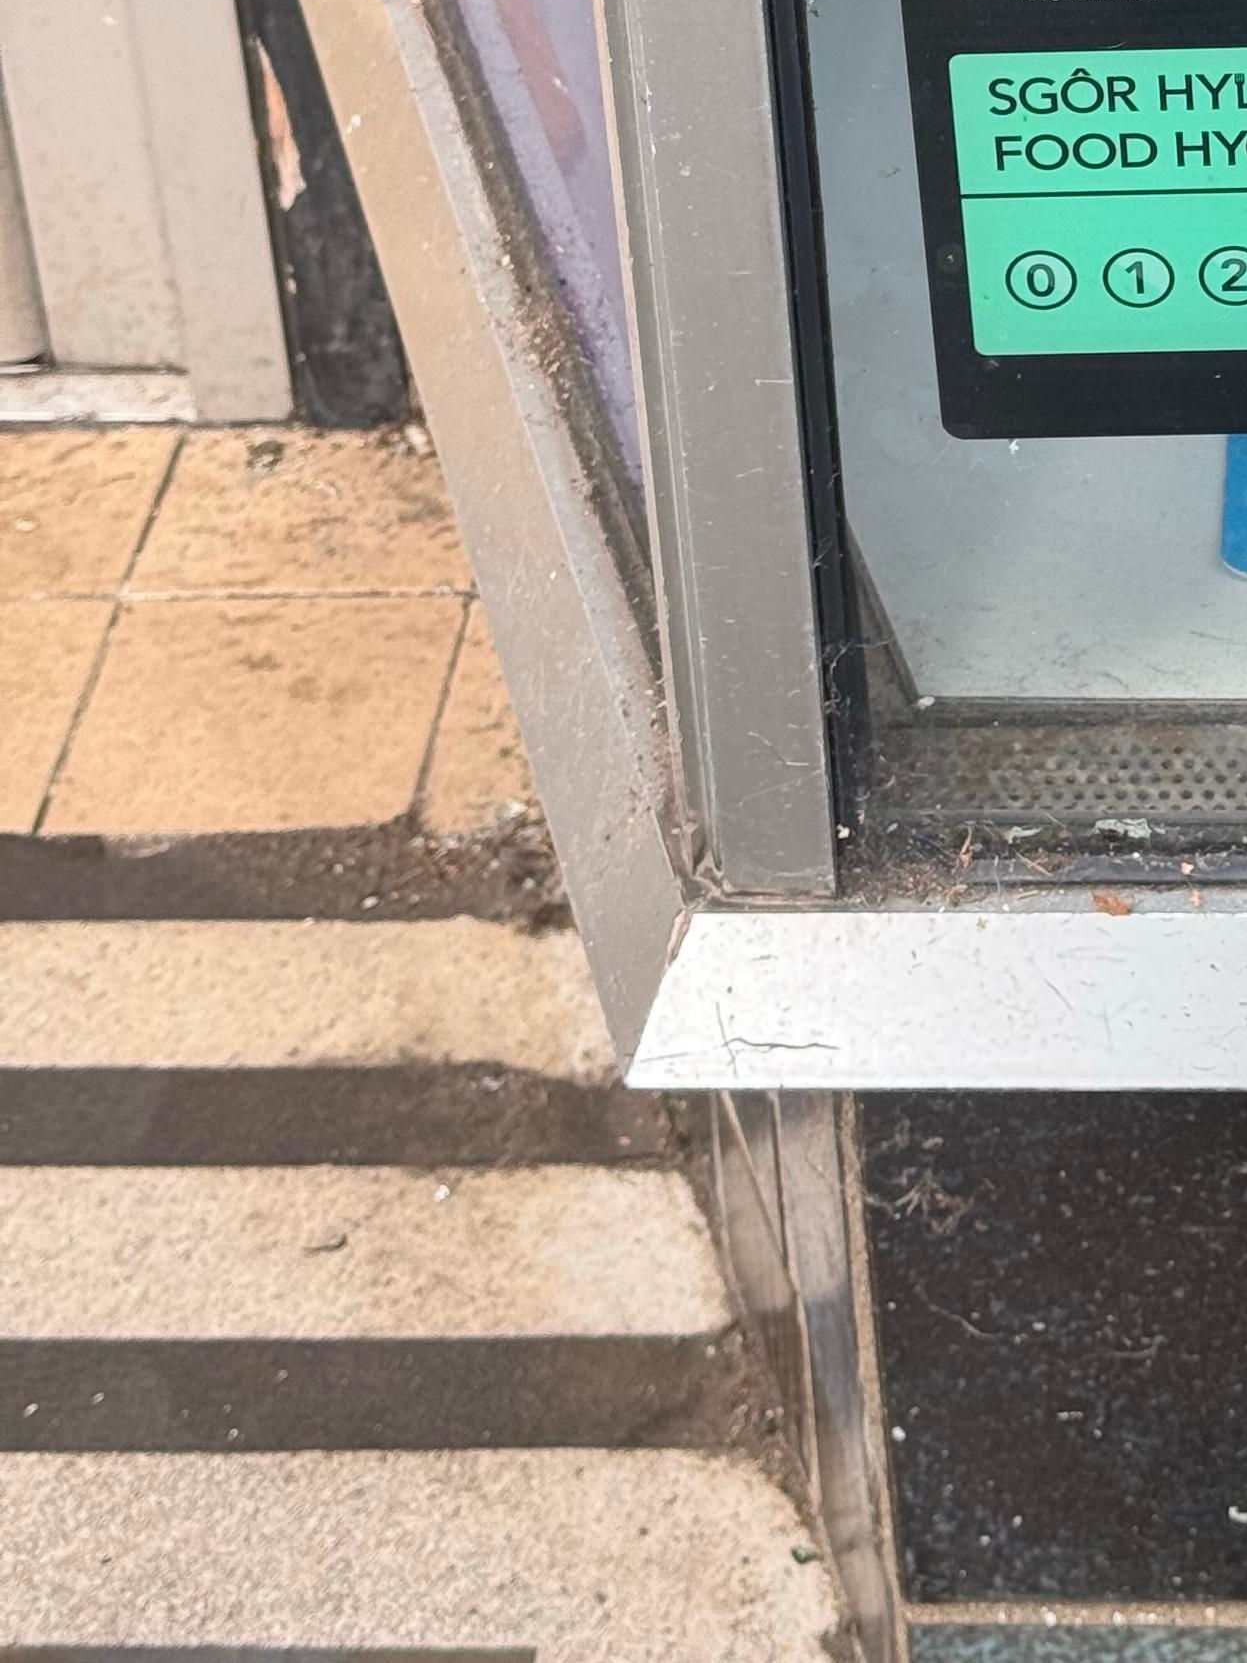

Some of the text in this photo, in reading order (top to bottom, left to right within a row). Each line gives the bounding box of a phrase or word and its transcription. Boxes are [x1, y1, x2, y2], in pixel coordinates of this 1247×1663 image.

[988, 69, 1137, 116] SGÔR
[995, 134, 1157, 172] FOOD
[1028, 263, 1054, 296] 0
[1124, 261, 1146, 294] 1
